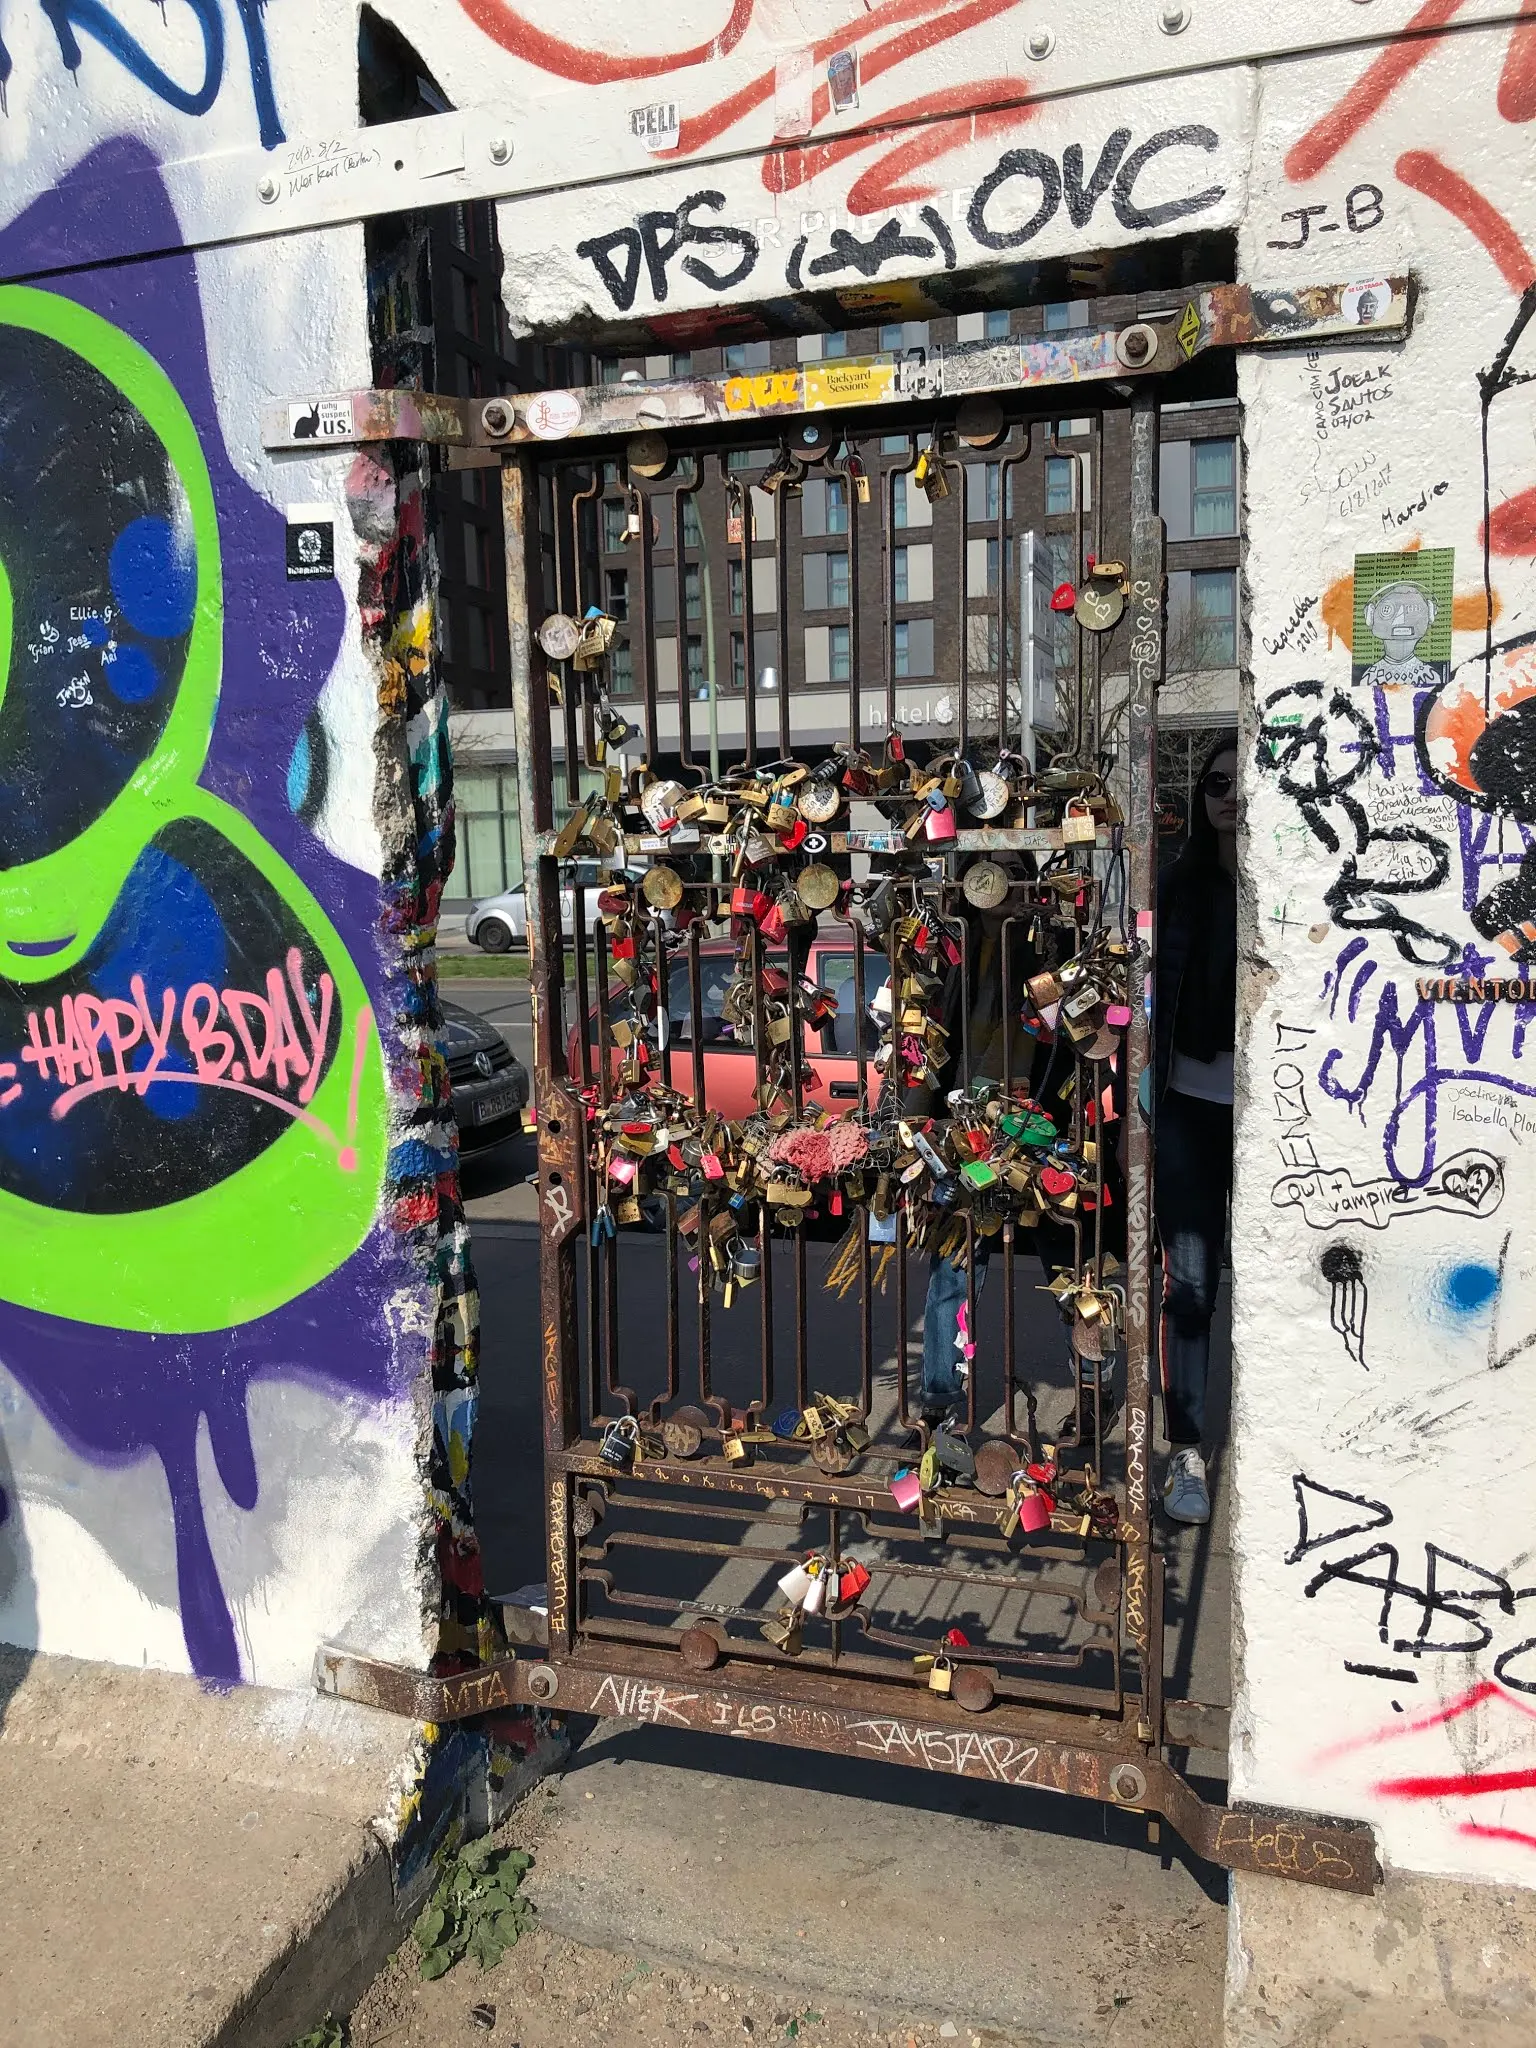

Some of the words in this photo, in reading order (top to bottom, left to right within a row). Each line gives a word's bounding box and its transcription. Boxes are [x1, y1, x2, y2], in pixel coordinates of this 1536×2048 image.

[1267, 184, 1385, 249] J-B
[826, 370, 871, 385] Backyard
[829, 382, 869, 393] Sessions
[321, 403, 338, 412] why
[321, 411, 350, 419] suspect
[869, 700, 930, 726] htel
[22, 974, 176, 1096] HAPPY
[1452, 1105, 1507, 1127] Isabella
[1288, 1172, 1325, 1200] owl
[1328, 1184, 1419, 1225] vampire
[442, 1670, 508, 1714] MTA
